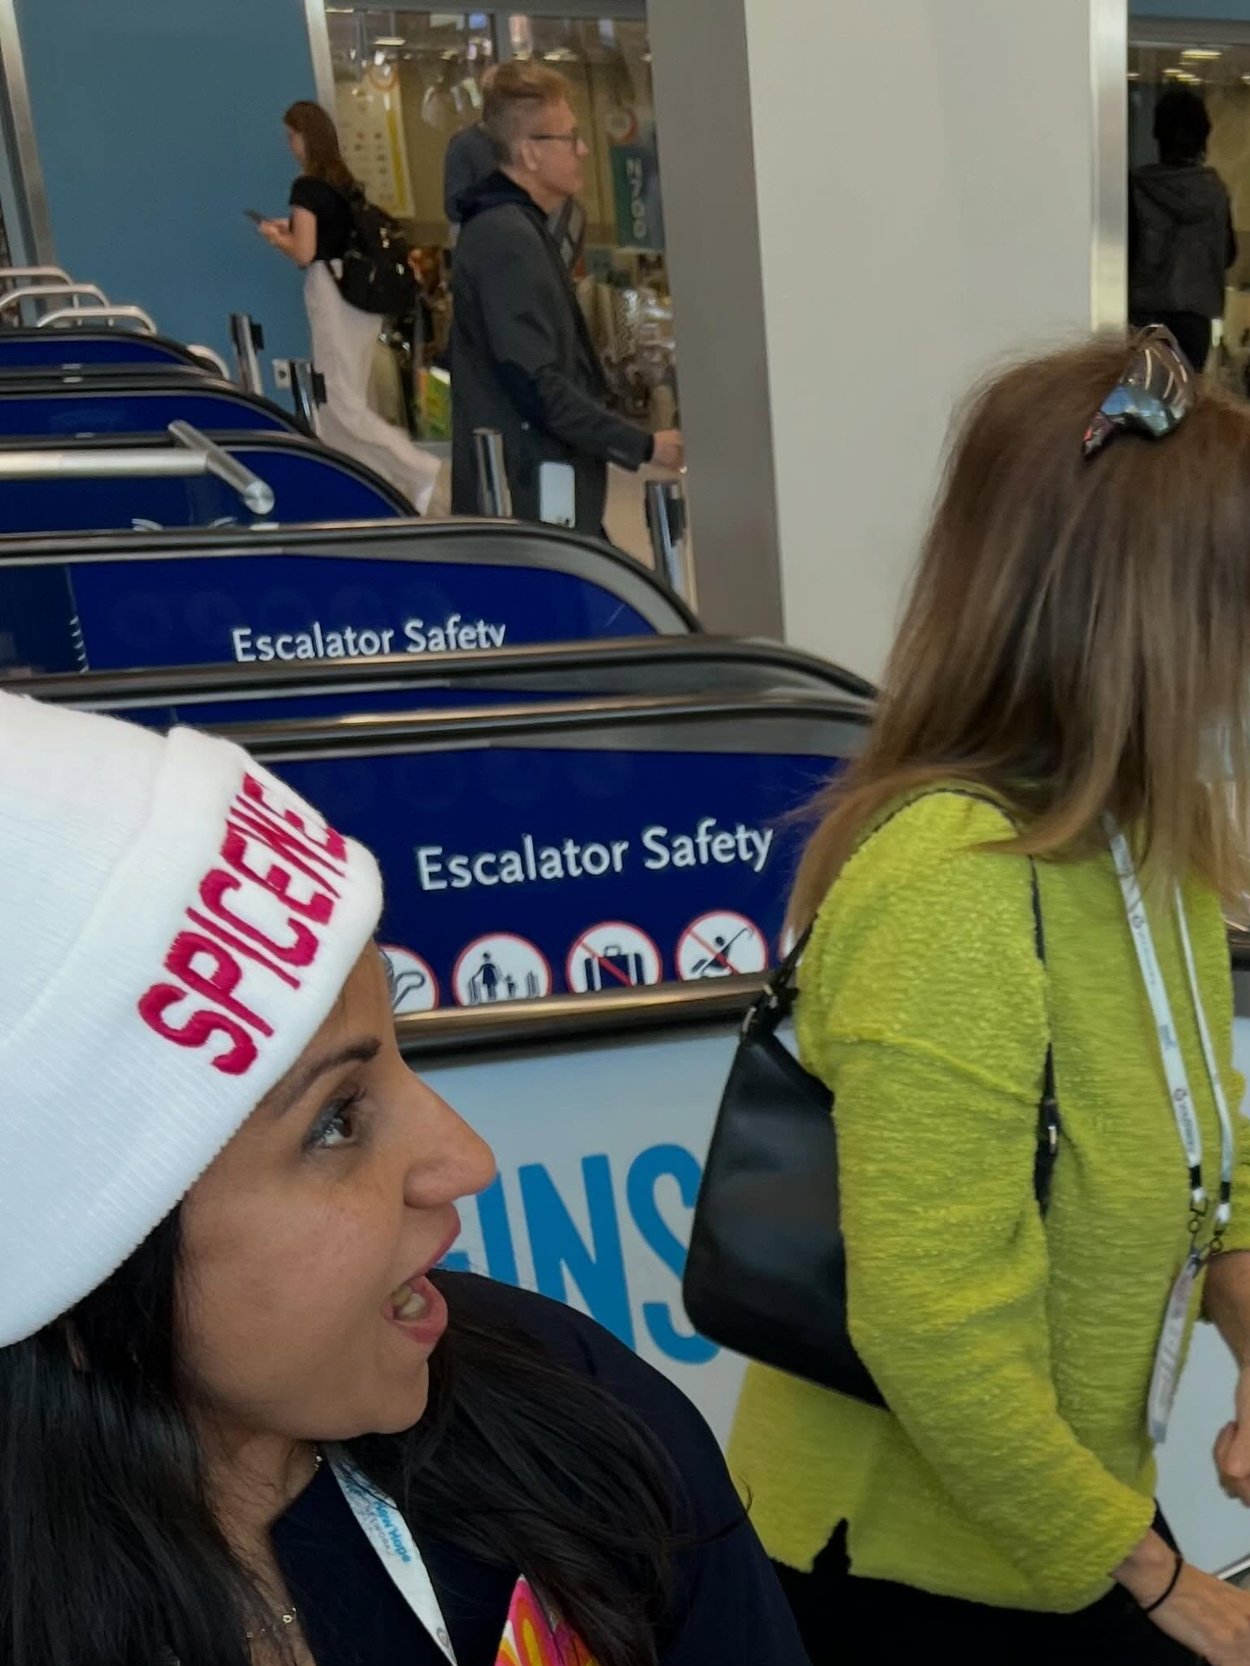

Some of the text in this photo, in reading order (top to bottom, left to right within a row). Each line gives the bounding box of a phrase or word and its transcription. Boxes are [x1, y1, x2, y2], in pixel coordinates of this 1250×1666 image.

[231, 621, 394, 663] Escalator
[418, 818, 773, 891] Escalator Safety
[388, 1527, 412, 1564] Hope
